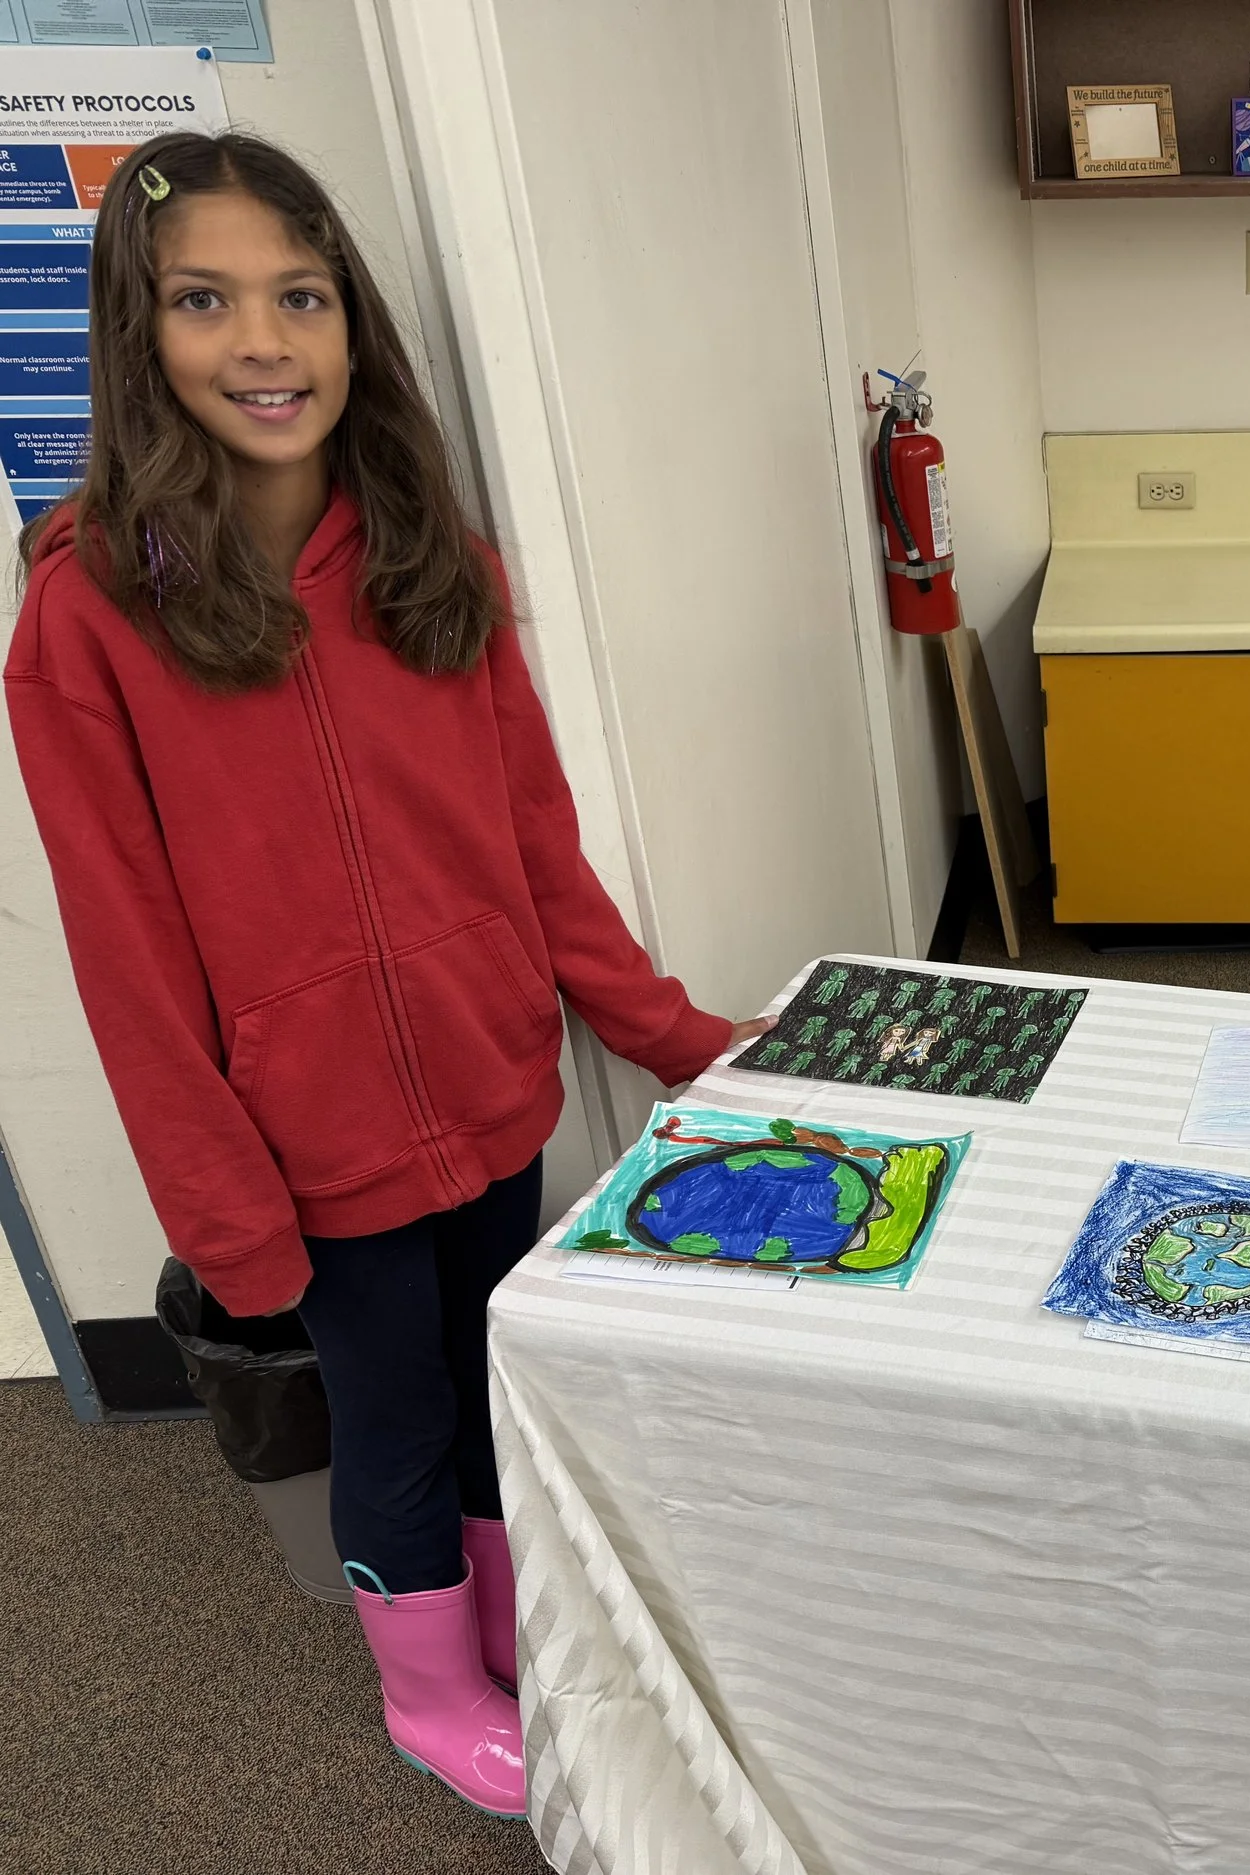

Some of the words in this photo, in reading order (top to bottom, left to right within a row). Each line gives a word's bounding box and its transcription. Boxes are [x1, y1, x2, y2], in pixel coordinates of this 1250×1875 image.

[1073, 90, 1089, 101] We
[1090, 89, 1115, 100] build
[1117, 89, 1134, 99] the
[1133, 88, 1164, 101] future
[0, 95, 65, 112] SAFETY
[72, 95, 196, 112] PROTOCOLS
[26, 120, 38, 128] the
[40, 120, 79, 128] differences
[80, 120, 112, 128] between
[119, 120, 143, 128] shelter
[145, 120, 153, 128] in
[154, 120, 174, 129] place
[31, 130, 51, 138] when
[52, 130, 86, 139] assessing
[92, 129, 115, 137] threat
[116, 129, 124, 137] to
[131, 129, 156, 137] school
[1084, 163, 1103, 173] one
[1103, 161, 1128, 173] child
[1128, 162, 1139, 171] at
[1148, 160, 1172, 170] time.
[52, 227, 85, 238] WHAT
[31, 266, 45, 274] and
[46, 266, 64, 274] staff
[64, 266, 88, 274] inside
[30, 275, 47, 283] lock
[47, 275, 71, 283] doors.
[0, 356, 28, 364] Normal
[28, 356, 66, 364] classroom
[23, 365, 39, 373] may
[40, 364, 75, 372] continue.
[14, 432, 31, 440] Only
[34, 449, 43, 457] by
[34, 458, 73, 466] emergency
